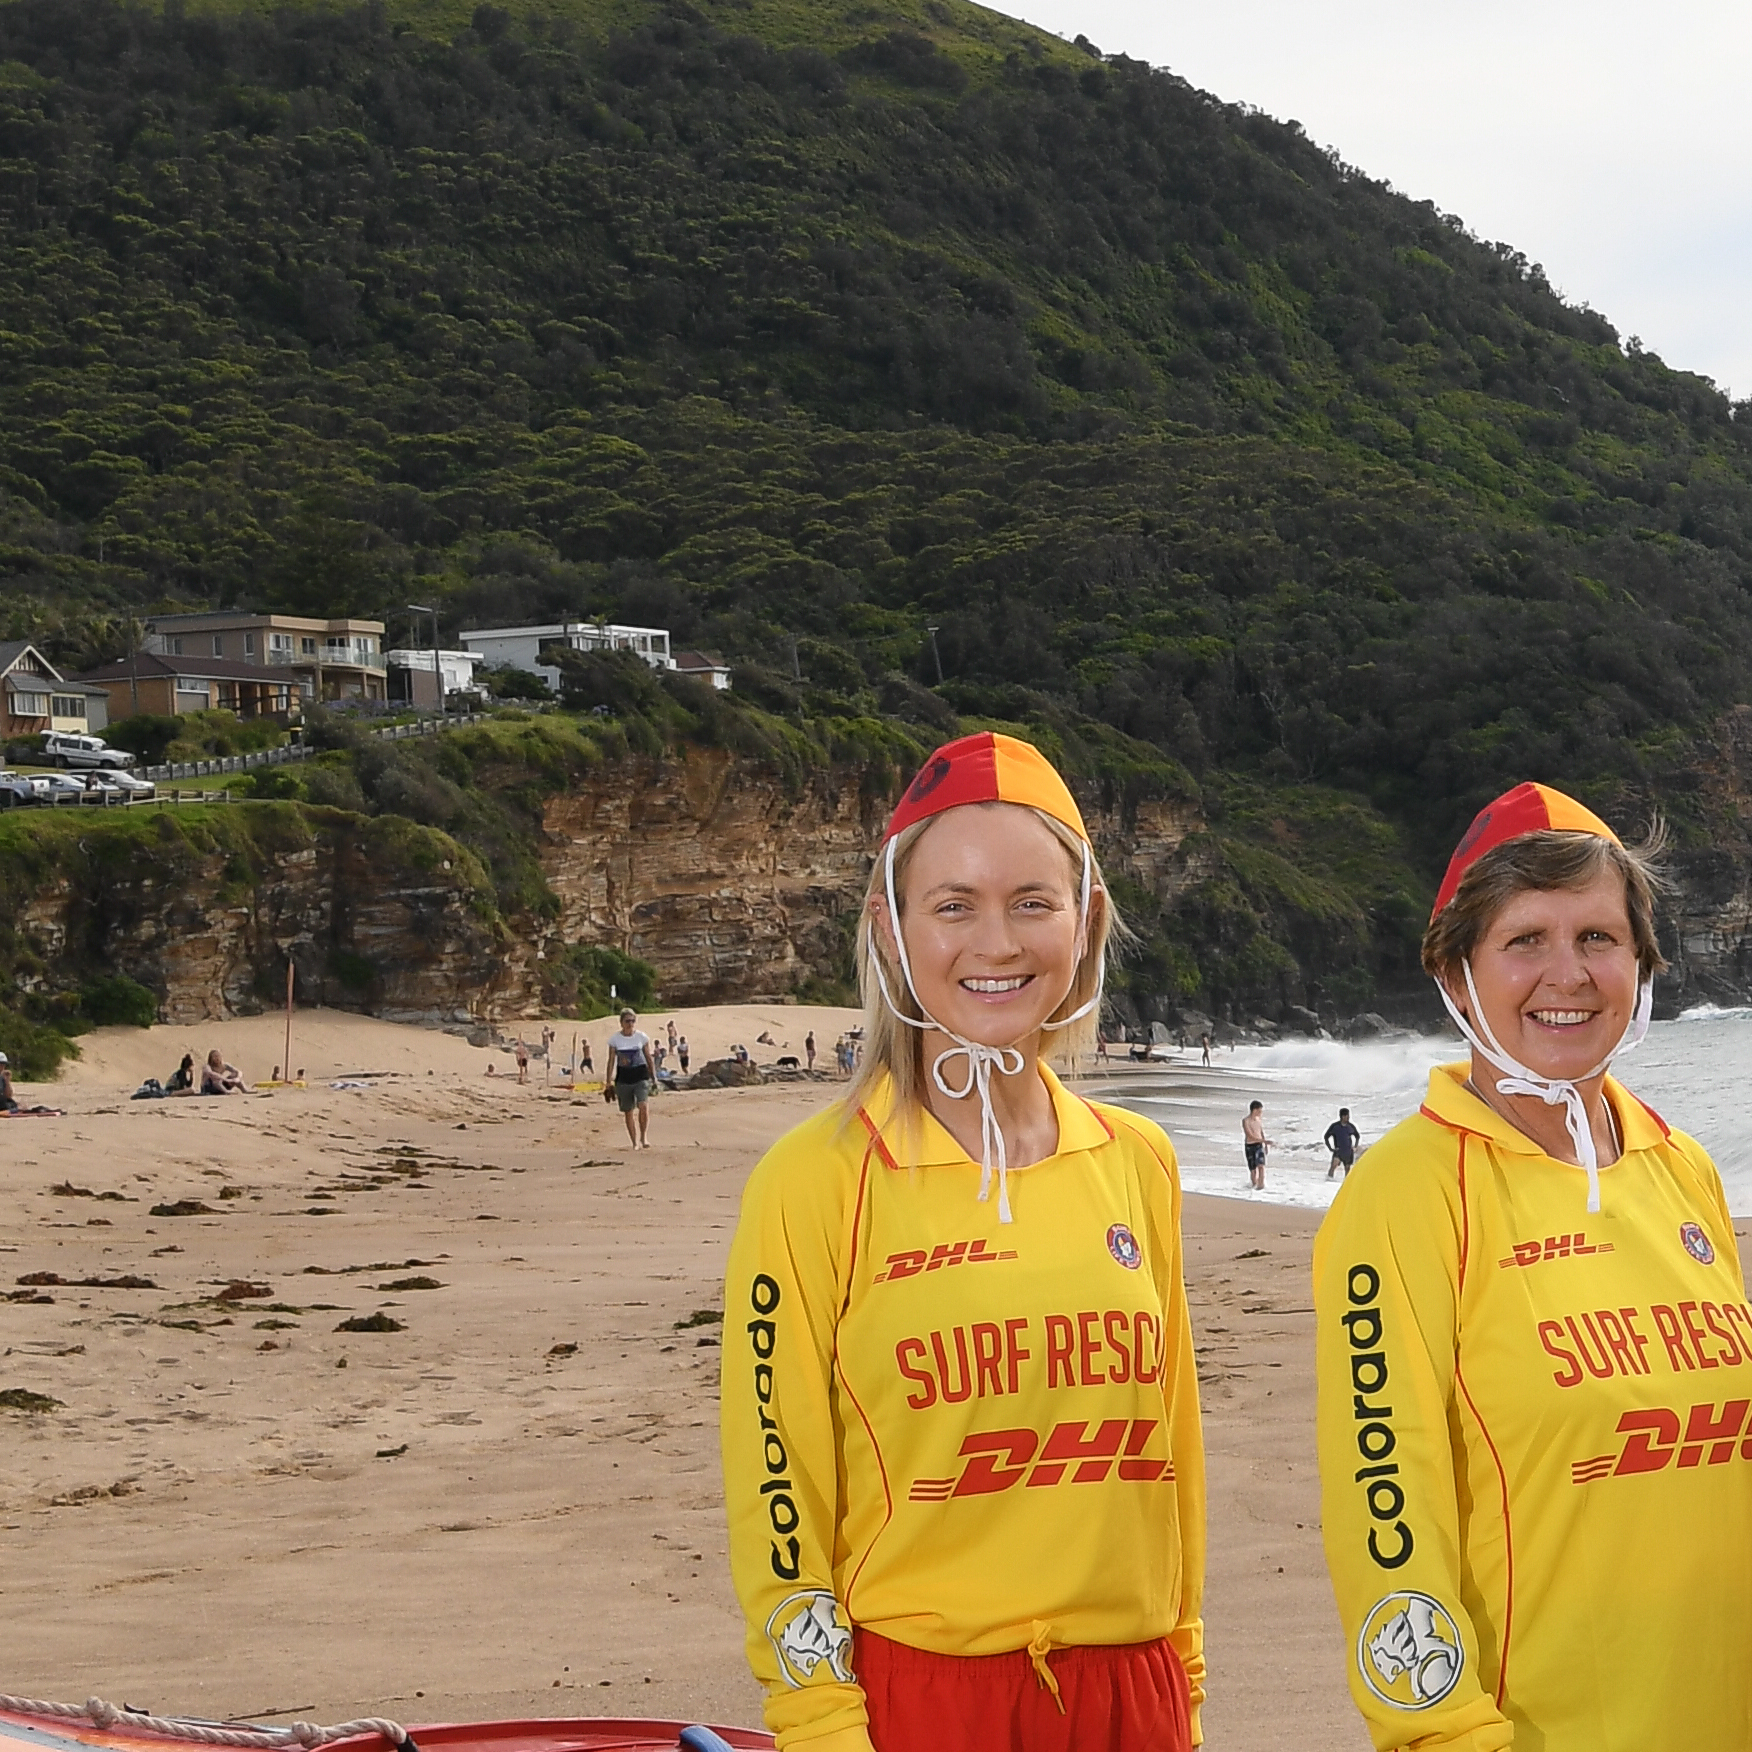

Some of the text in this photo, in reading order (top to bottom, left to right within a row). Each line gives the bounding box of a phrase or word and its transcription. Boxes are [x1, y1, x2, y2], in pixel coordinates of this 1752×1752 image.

[886, 1238, 998, 1281] DHL
[1512, 1232, 1597, 1267] DHL
[895, 1315, 1031, 1410] SURF
[1537, 1306, 1652, 1388] SURF
[747, 1273, 800, 1581] Colorado
[1341, 1263, 1414, 1570] Colorado
[950, 1418, 1168, 1498] DHL
